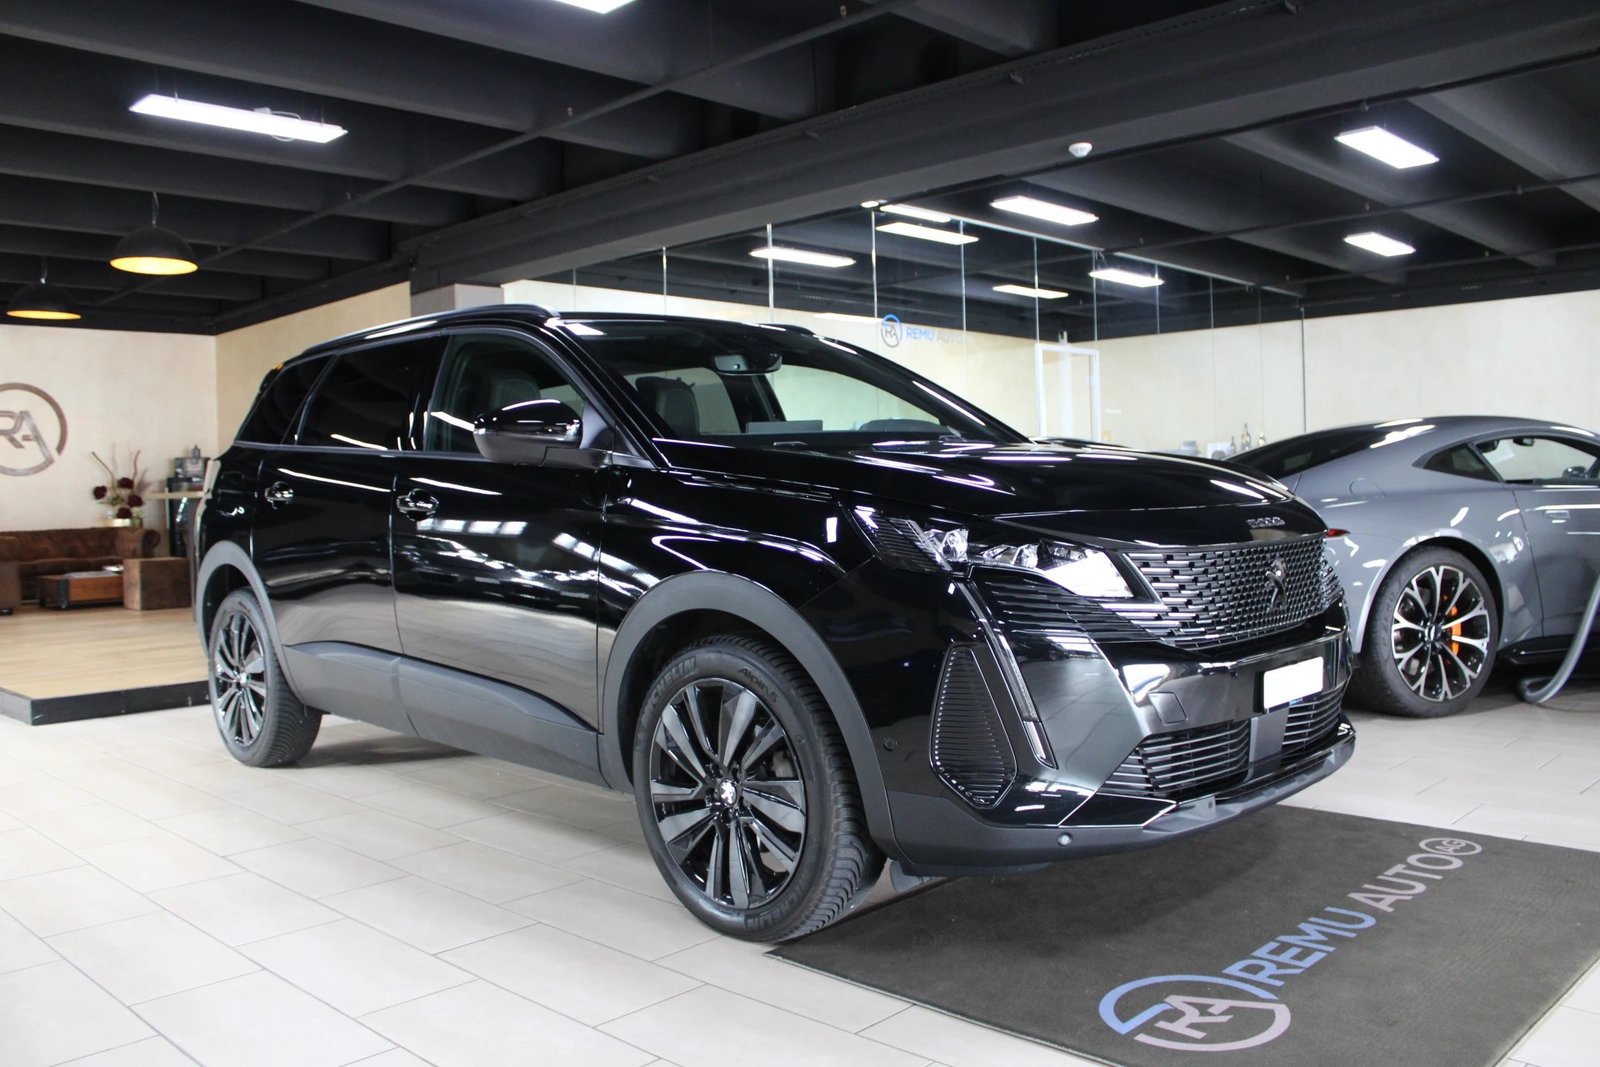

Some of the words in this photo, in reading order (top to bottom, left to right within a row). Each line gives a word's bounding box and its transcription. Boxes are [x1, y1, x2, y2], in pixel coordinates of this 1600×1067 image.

[906, 326, 935, 341] REMU
[1222, 906, 1377, 987] REMU
[1347, 852, 1464, 913] AUTO
